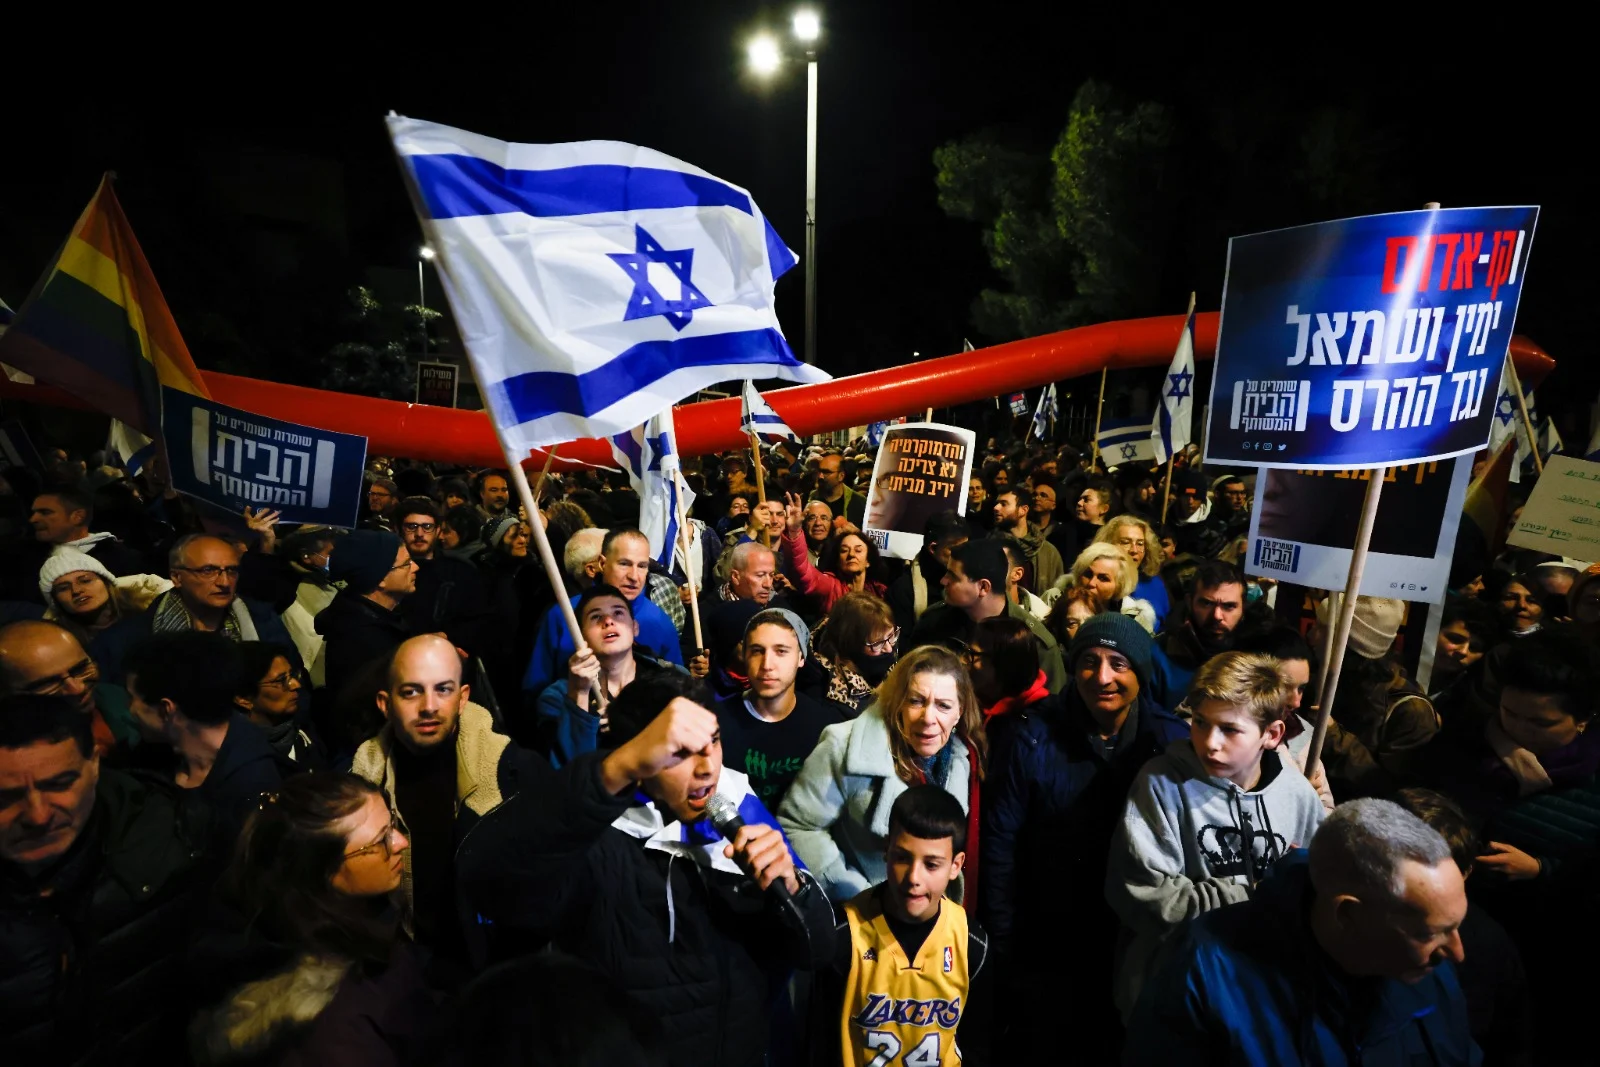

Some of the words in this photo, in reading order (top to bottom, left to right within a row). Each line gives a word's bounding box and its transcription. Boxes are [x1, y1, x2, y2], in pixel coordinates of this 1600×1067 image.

[1381, 230, 1525, 300] וקו-אדום
[1285, 304, 1445, 366] ושמאל
[1446, 301, 1503, 373] ימין
[1246, 379, 1259, 392] על
[1260, 380, 1297, 392] שומרים
[1450, 368, 1489, 422] נגד
[1242, 393, 1296, 417] הבית
[1329, 375, 1442, 433] ההרס
[215, 411, 228, 425] על
[230, 417, 272, 438] ושומרים
[1241, 417, 1293, 433] המשותף
[274, 429, 312, 447] שומרות
[213, 430, 310, 487] הבית
[889, 438, 965, 460] והדמוקרטיה
[898, 457, 937, 476] צריכה
[939, 461, 958, 479] לא
[214, 471, 307, 506] המשותף
[888, 476, 925, 494] מבית!
[927, 481, 955, 498] יריב
[1261, 546, 1293, 564] הבית
[851, 992, 961, 1029] LAKERS
[864, 1031, 942, 1067] 24
